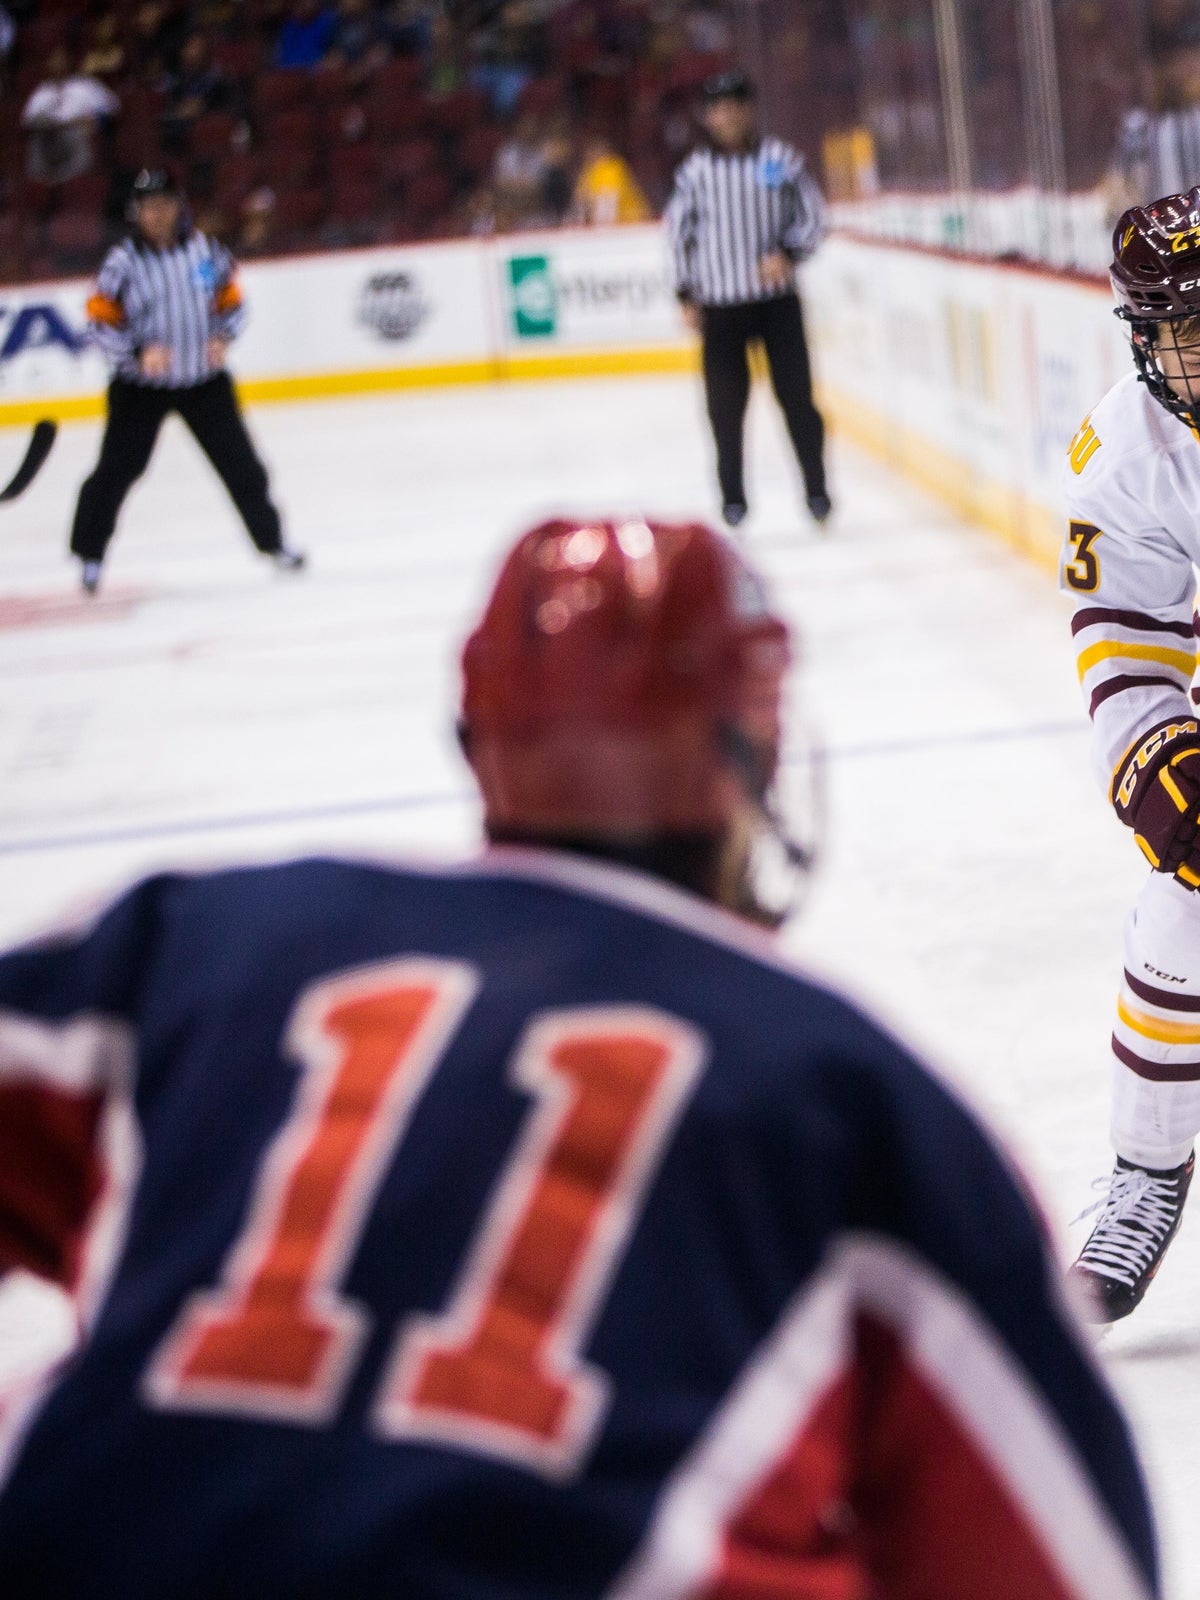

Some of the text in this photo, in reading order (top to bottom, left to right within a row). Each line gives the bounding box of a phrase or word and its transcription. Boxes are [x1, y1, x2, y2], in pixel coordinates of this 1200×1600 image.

[1114, 720, 1198, 809] CCM
[1143, 961, 1188, 985] CCM
[142, 951, 712, 1482] 11
